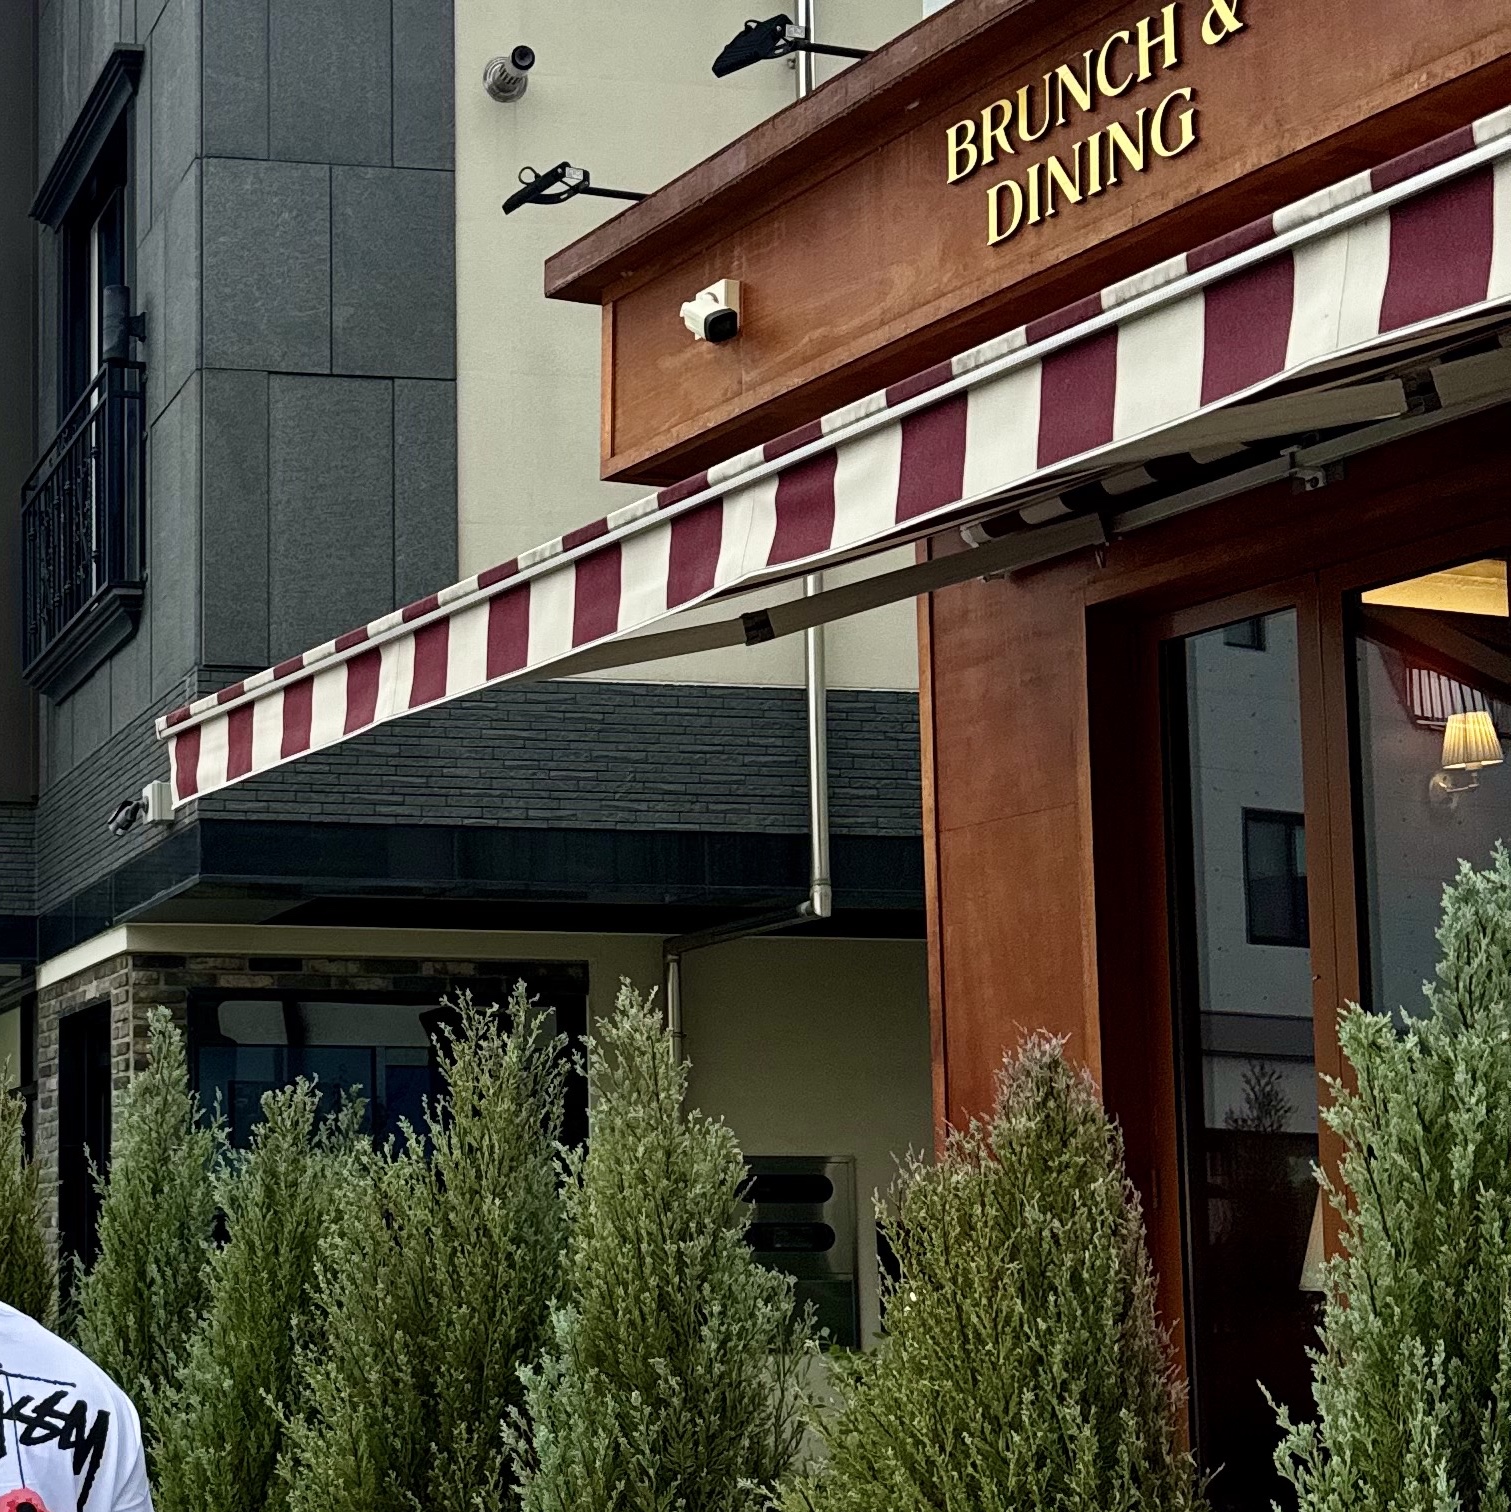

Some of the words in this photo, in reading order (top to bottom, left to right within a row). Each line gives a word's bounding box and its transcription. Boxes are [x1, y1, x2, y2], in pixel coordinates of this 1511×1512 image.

[946, 2, 1178, 184] BRUNCH
[1201, 0, 1244, 45] &
[986, 87, 1196, 246] DINING
